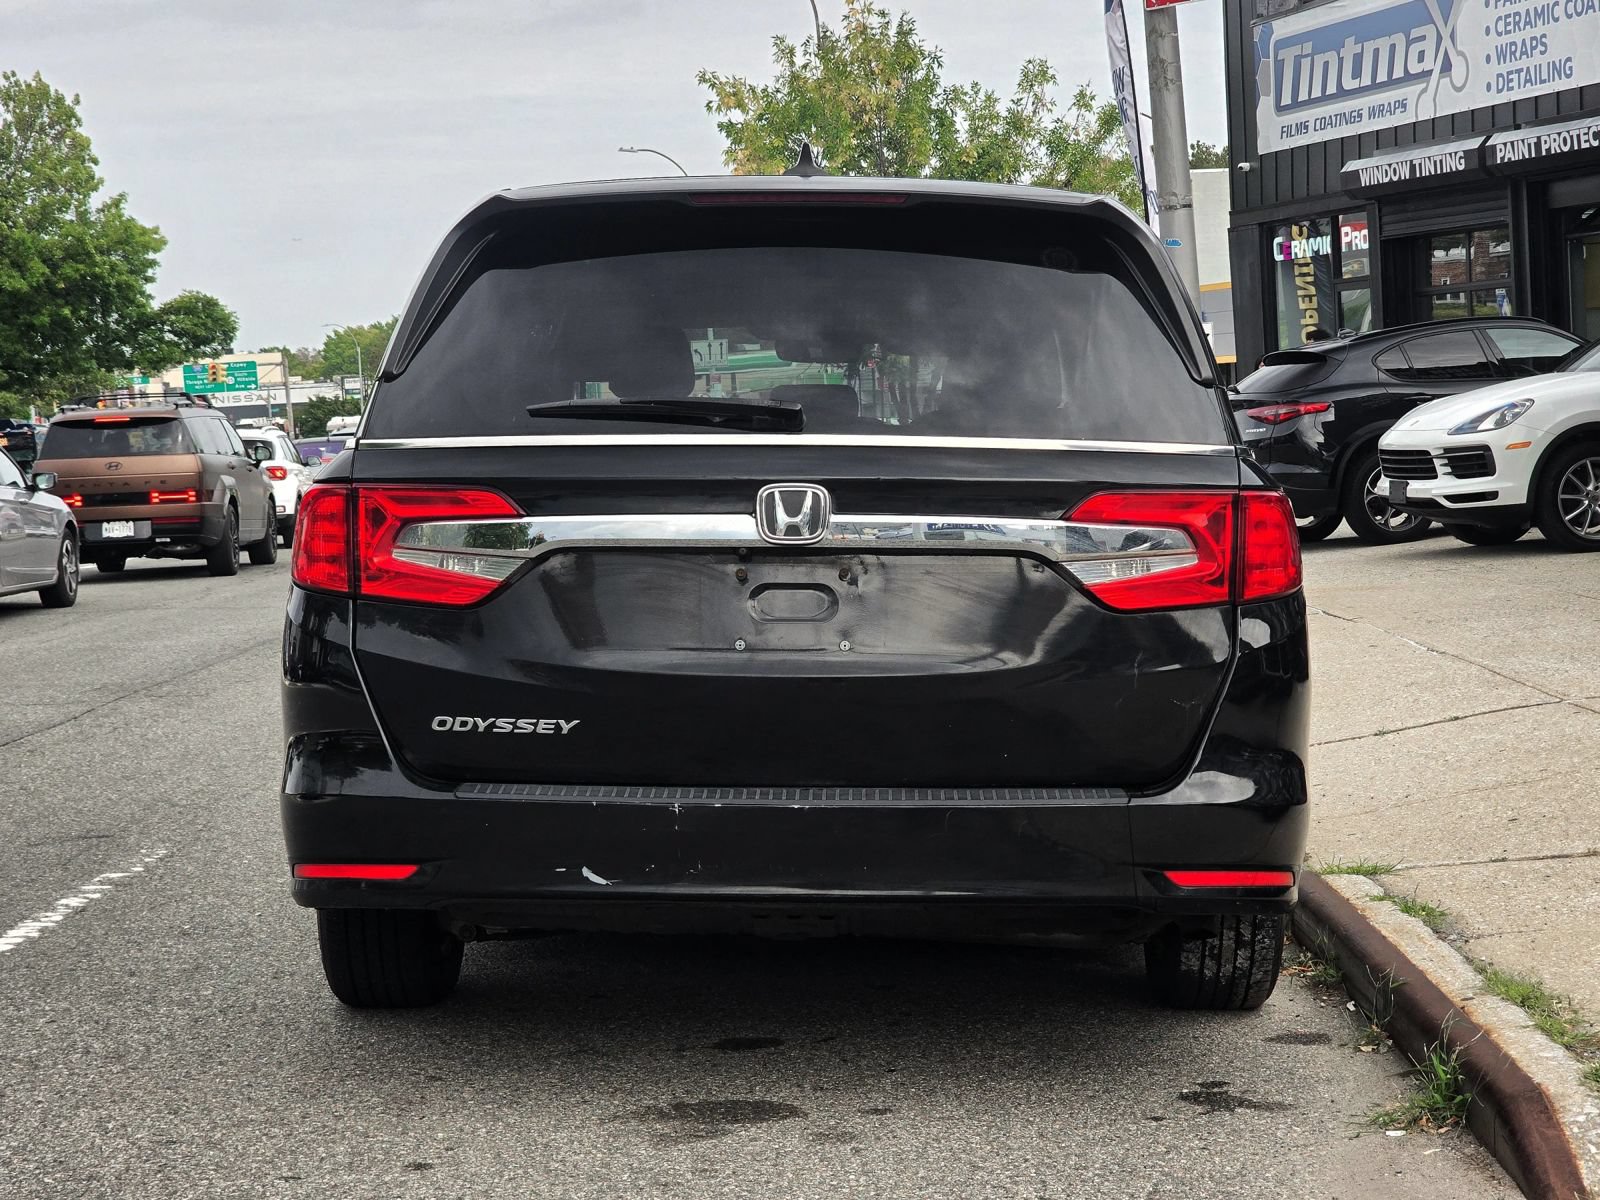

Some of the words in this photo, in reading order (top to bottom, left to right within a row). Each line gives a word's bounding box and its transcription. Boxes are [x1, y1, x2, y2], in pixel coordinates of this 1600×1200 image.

[1494, 1, 1560, 37] CERAMIC
[1564, 0, 1600, 20] COA
[1494, 33, 1548, 66] WRAPS
[1495, 56, 1574, 94] DETAILING
[1280, 119, 1310, 139] FILMS
[1313, 108, 1364, 132] COATINGS
[1368, 98, 1408, 121] WRAPS
[1496, 137, 1538, 164] PAINT
[1541, 125, 1600, 156] PROTEC
[1359, 160, 1411, 187] WINDOW
[1413, 151, 1465, 178] TINTING
[215, 393, 277, 404] NISSAN
[431, 716, 581, 735] ODYSSEY
